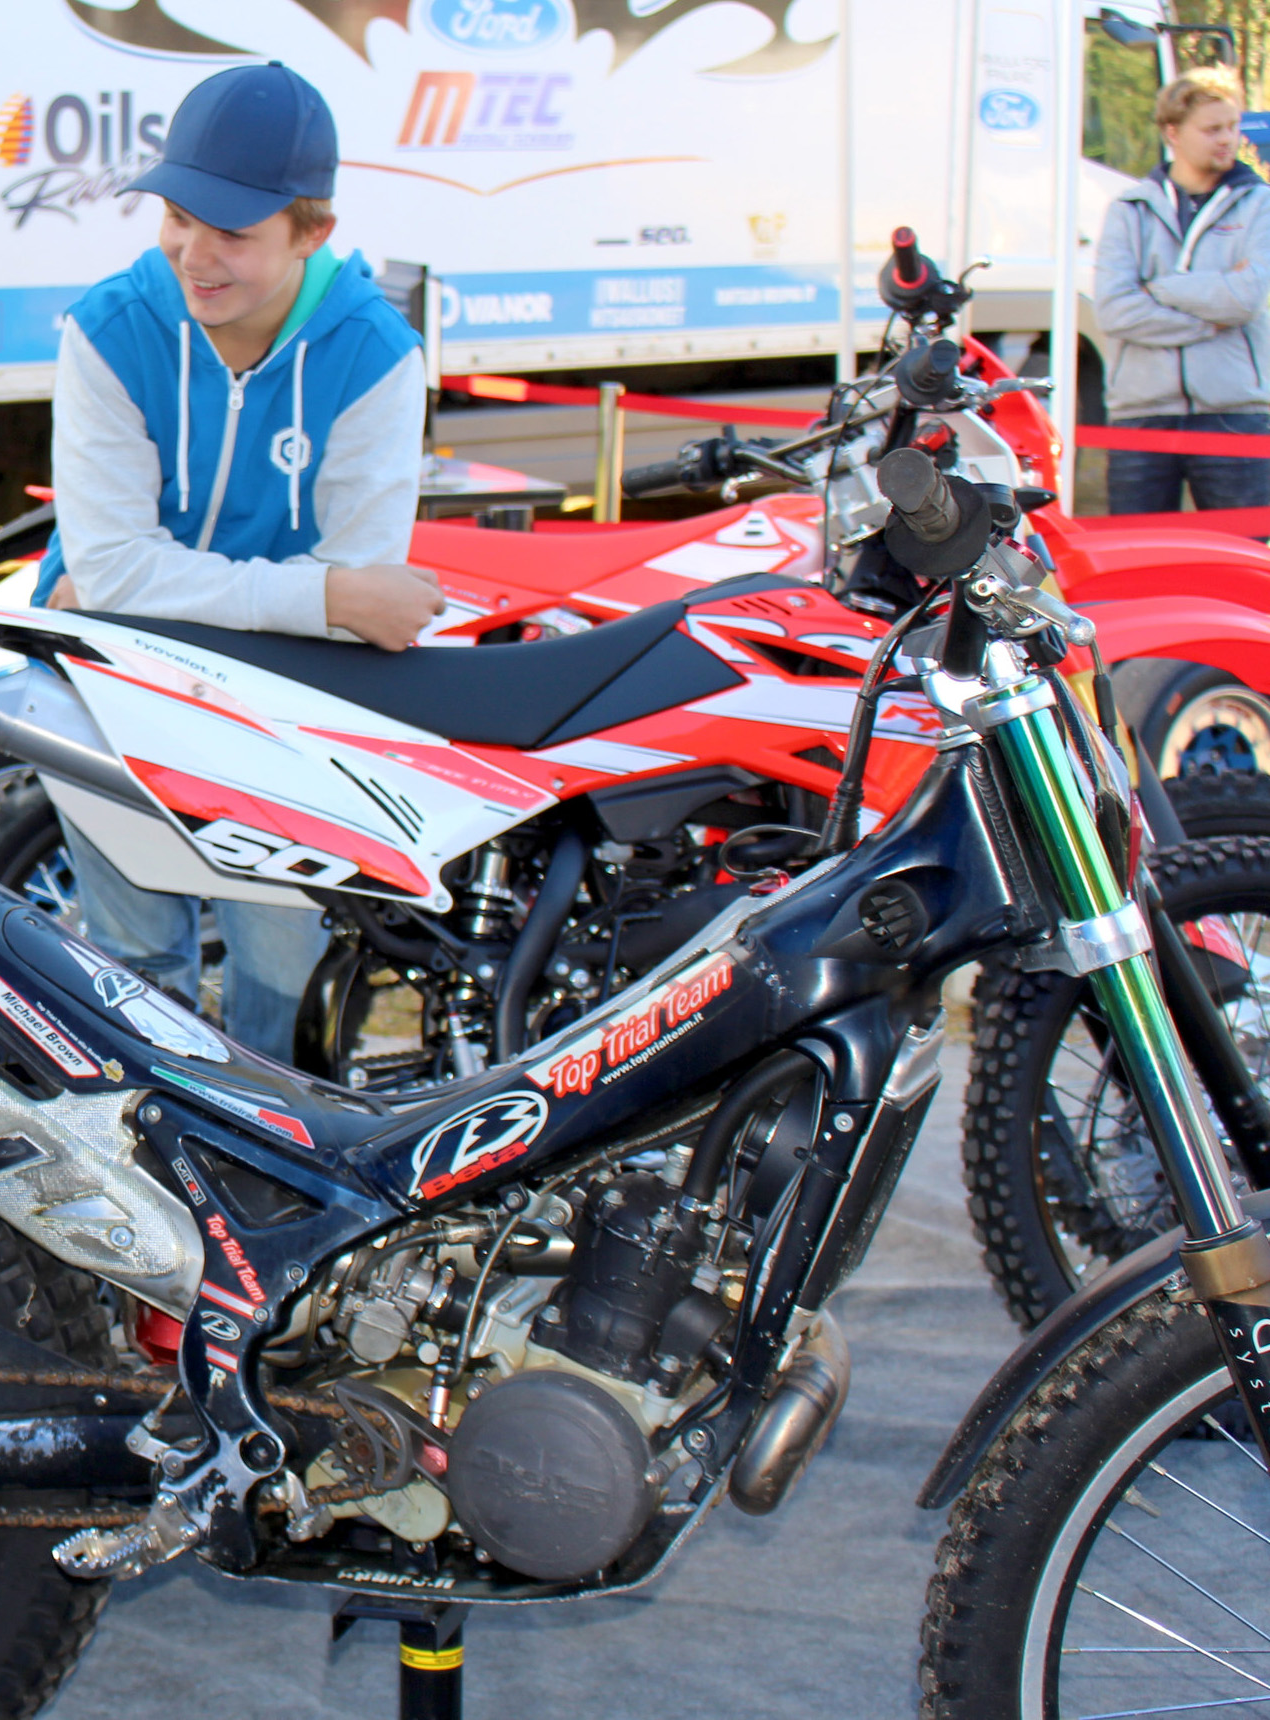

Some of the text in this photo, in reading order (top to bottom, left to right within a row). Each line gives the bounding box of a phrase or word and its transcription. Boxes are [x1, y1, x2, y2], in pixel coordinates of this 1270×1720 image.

[448, 0, 542, 42] Ford
[45, 91, 164, 168] Oils
[396, 71, 572, 146] MTEC
[192, 817, 362, 888] 50
[0, 990, 84, 1068] Michael Brown
[549, 961, 733, 1098] Top Trial Team
[600, 1011, 705, 1086] www.toptrialteam.it
[188, 1083, 295, 1139] www.trialrace.com
[205, 1212, 267, 1304] Top Trial Team
